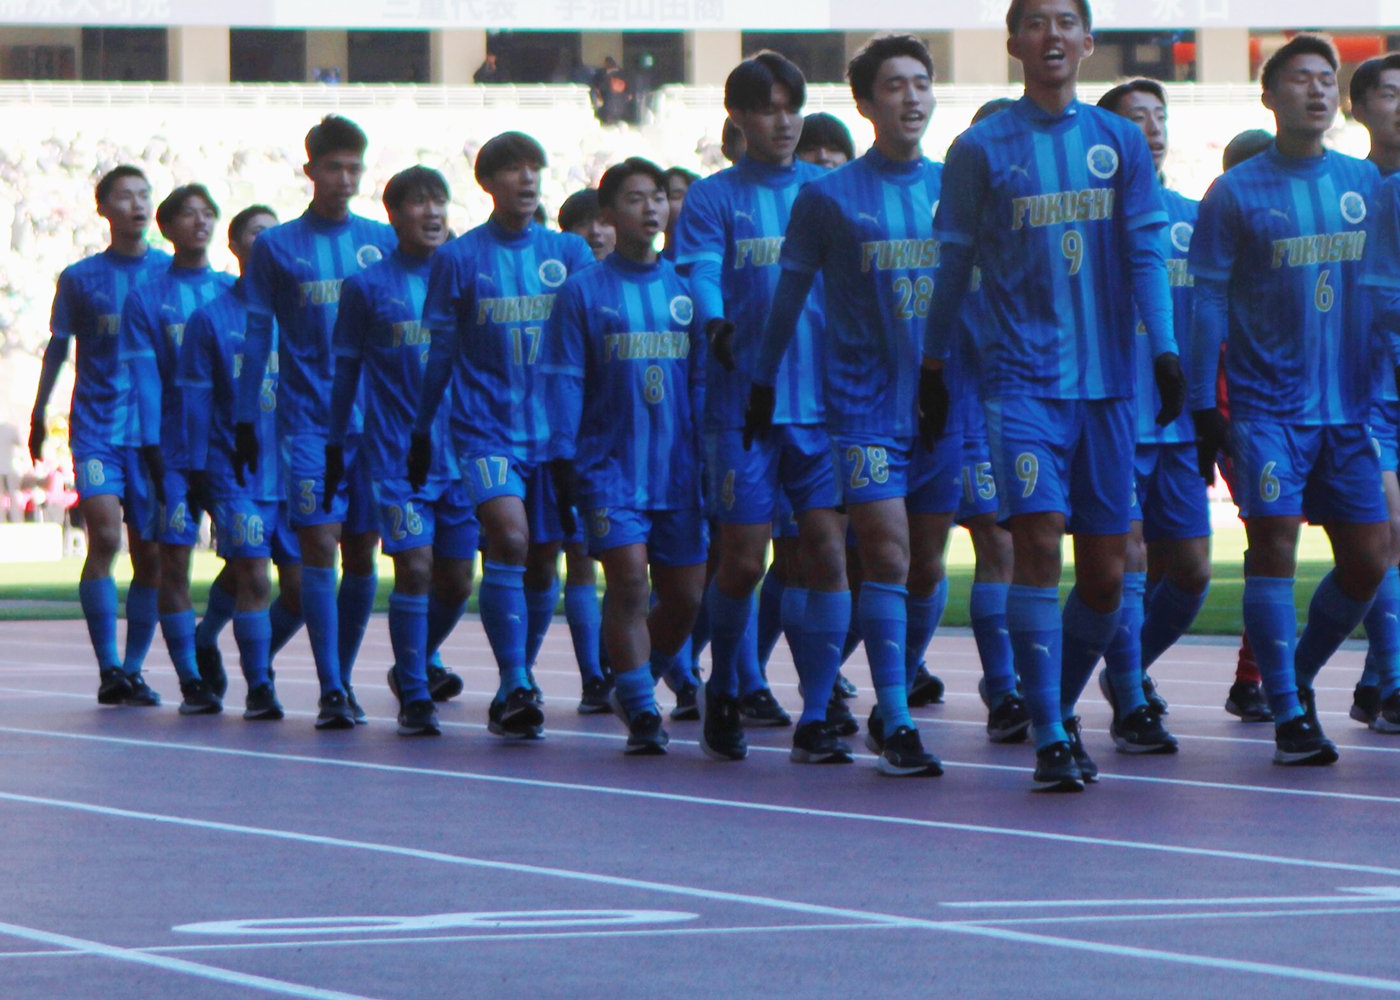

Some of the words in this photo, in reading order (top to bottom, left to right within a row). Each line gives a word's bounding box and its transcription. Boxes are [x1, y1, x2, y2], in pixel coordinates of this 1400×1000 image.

[1061, 230, 1083, 275] 9
[892, 276, 935, 320] 28
[1313, 269, 1334, 312] 6
[511, 326, 542, 366] 17
[644, 366, 665, 404] 8
[476, 456, 509, 489] 17
[846, 445, 890, 490] 28
[961, 461, 997, 505] 15
[1015, 456, 1039, 499] 9
[1259, 460, 1280, 503] 6
[297, 478, 317, 515] 3
[231, 513, 266, 547] 30
[389, 501, 424, 540] 26
